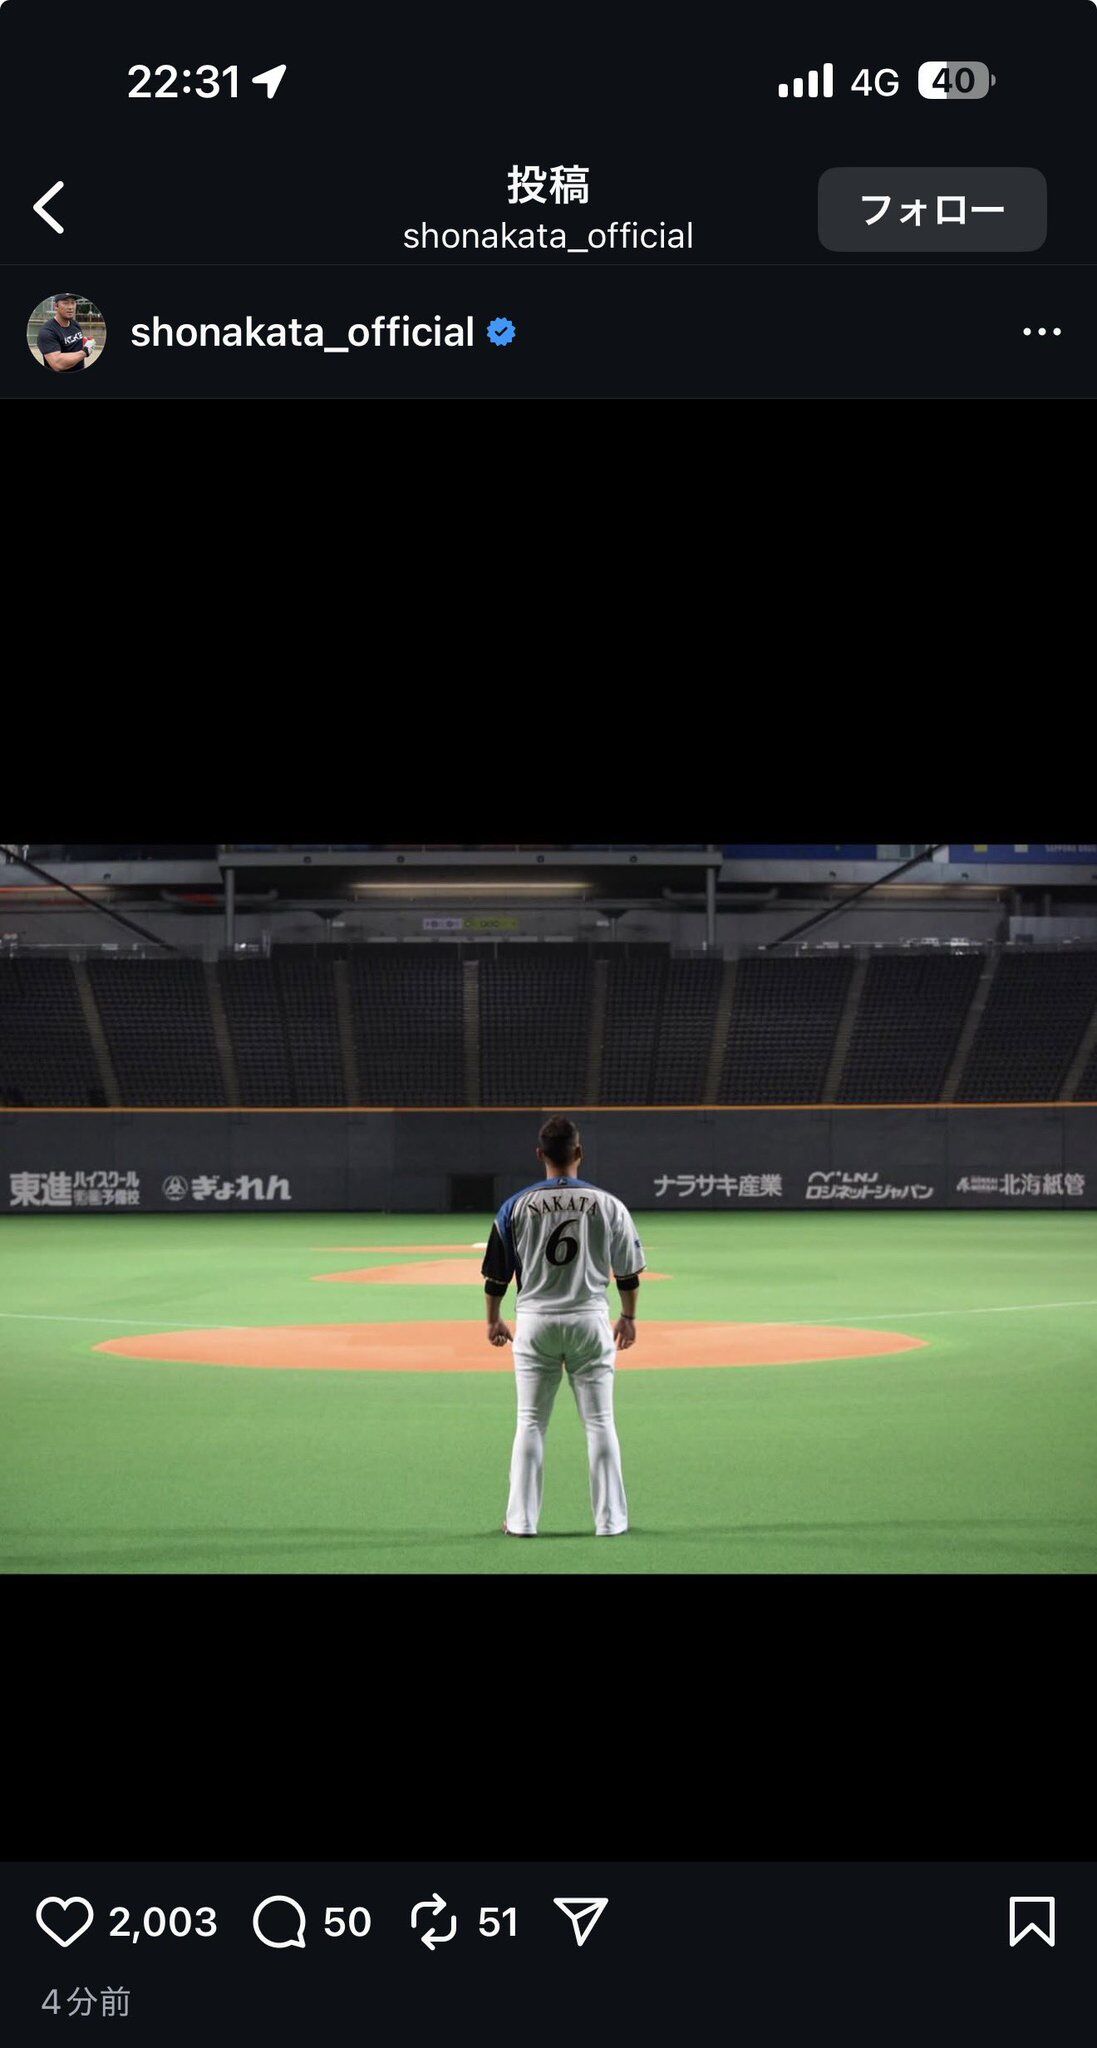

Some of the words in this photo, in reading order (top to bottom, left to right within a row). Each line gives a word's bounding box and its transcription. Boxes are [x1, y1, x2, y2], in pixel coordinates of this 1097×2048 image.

[128, 65, 240, 98] 22:31
[851, 68, 899, 96] 4G
[932, 67, 975, 94] 40
[507, 165, 590, 205] 投稿
[861, 195, 1005, 226] フォロー
[403, 222, 693, 252] shonakata_official
[131, 315, 474, 353] shonakata_official
[9, 1171, 72, 1207] 東進
[73, 1171, 140, 1188] ハイスクール
[191, 1175, 292, 1200] ぎょれん
[654, 1173, 783, 1197] ナラサキ産業
[805, 1184, 934, 1200] ロジネットジャパン
[528, 1195, 599, 1216] NAKATA
[545, 1218, 580, 1267] 6
[109, 1906, 218, 1943] 2,003
[324, 1906, 372, 1937] 50
[478, 1906, 516, 1937] 51
[41, 1986, 131, 2017] 4分前
